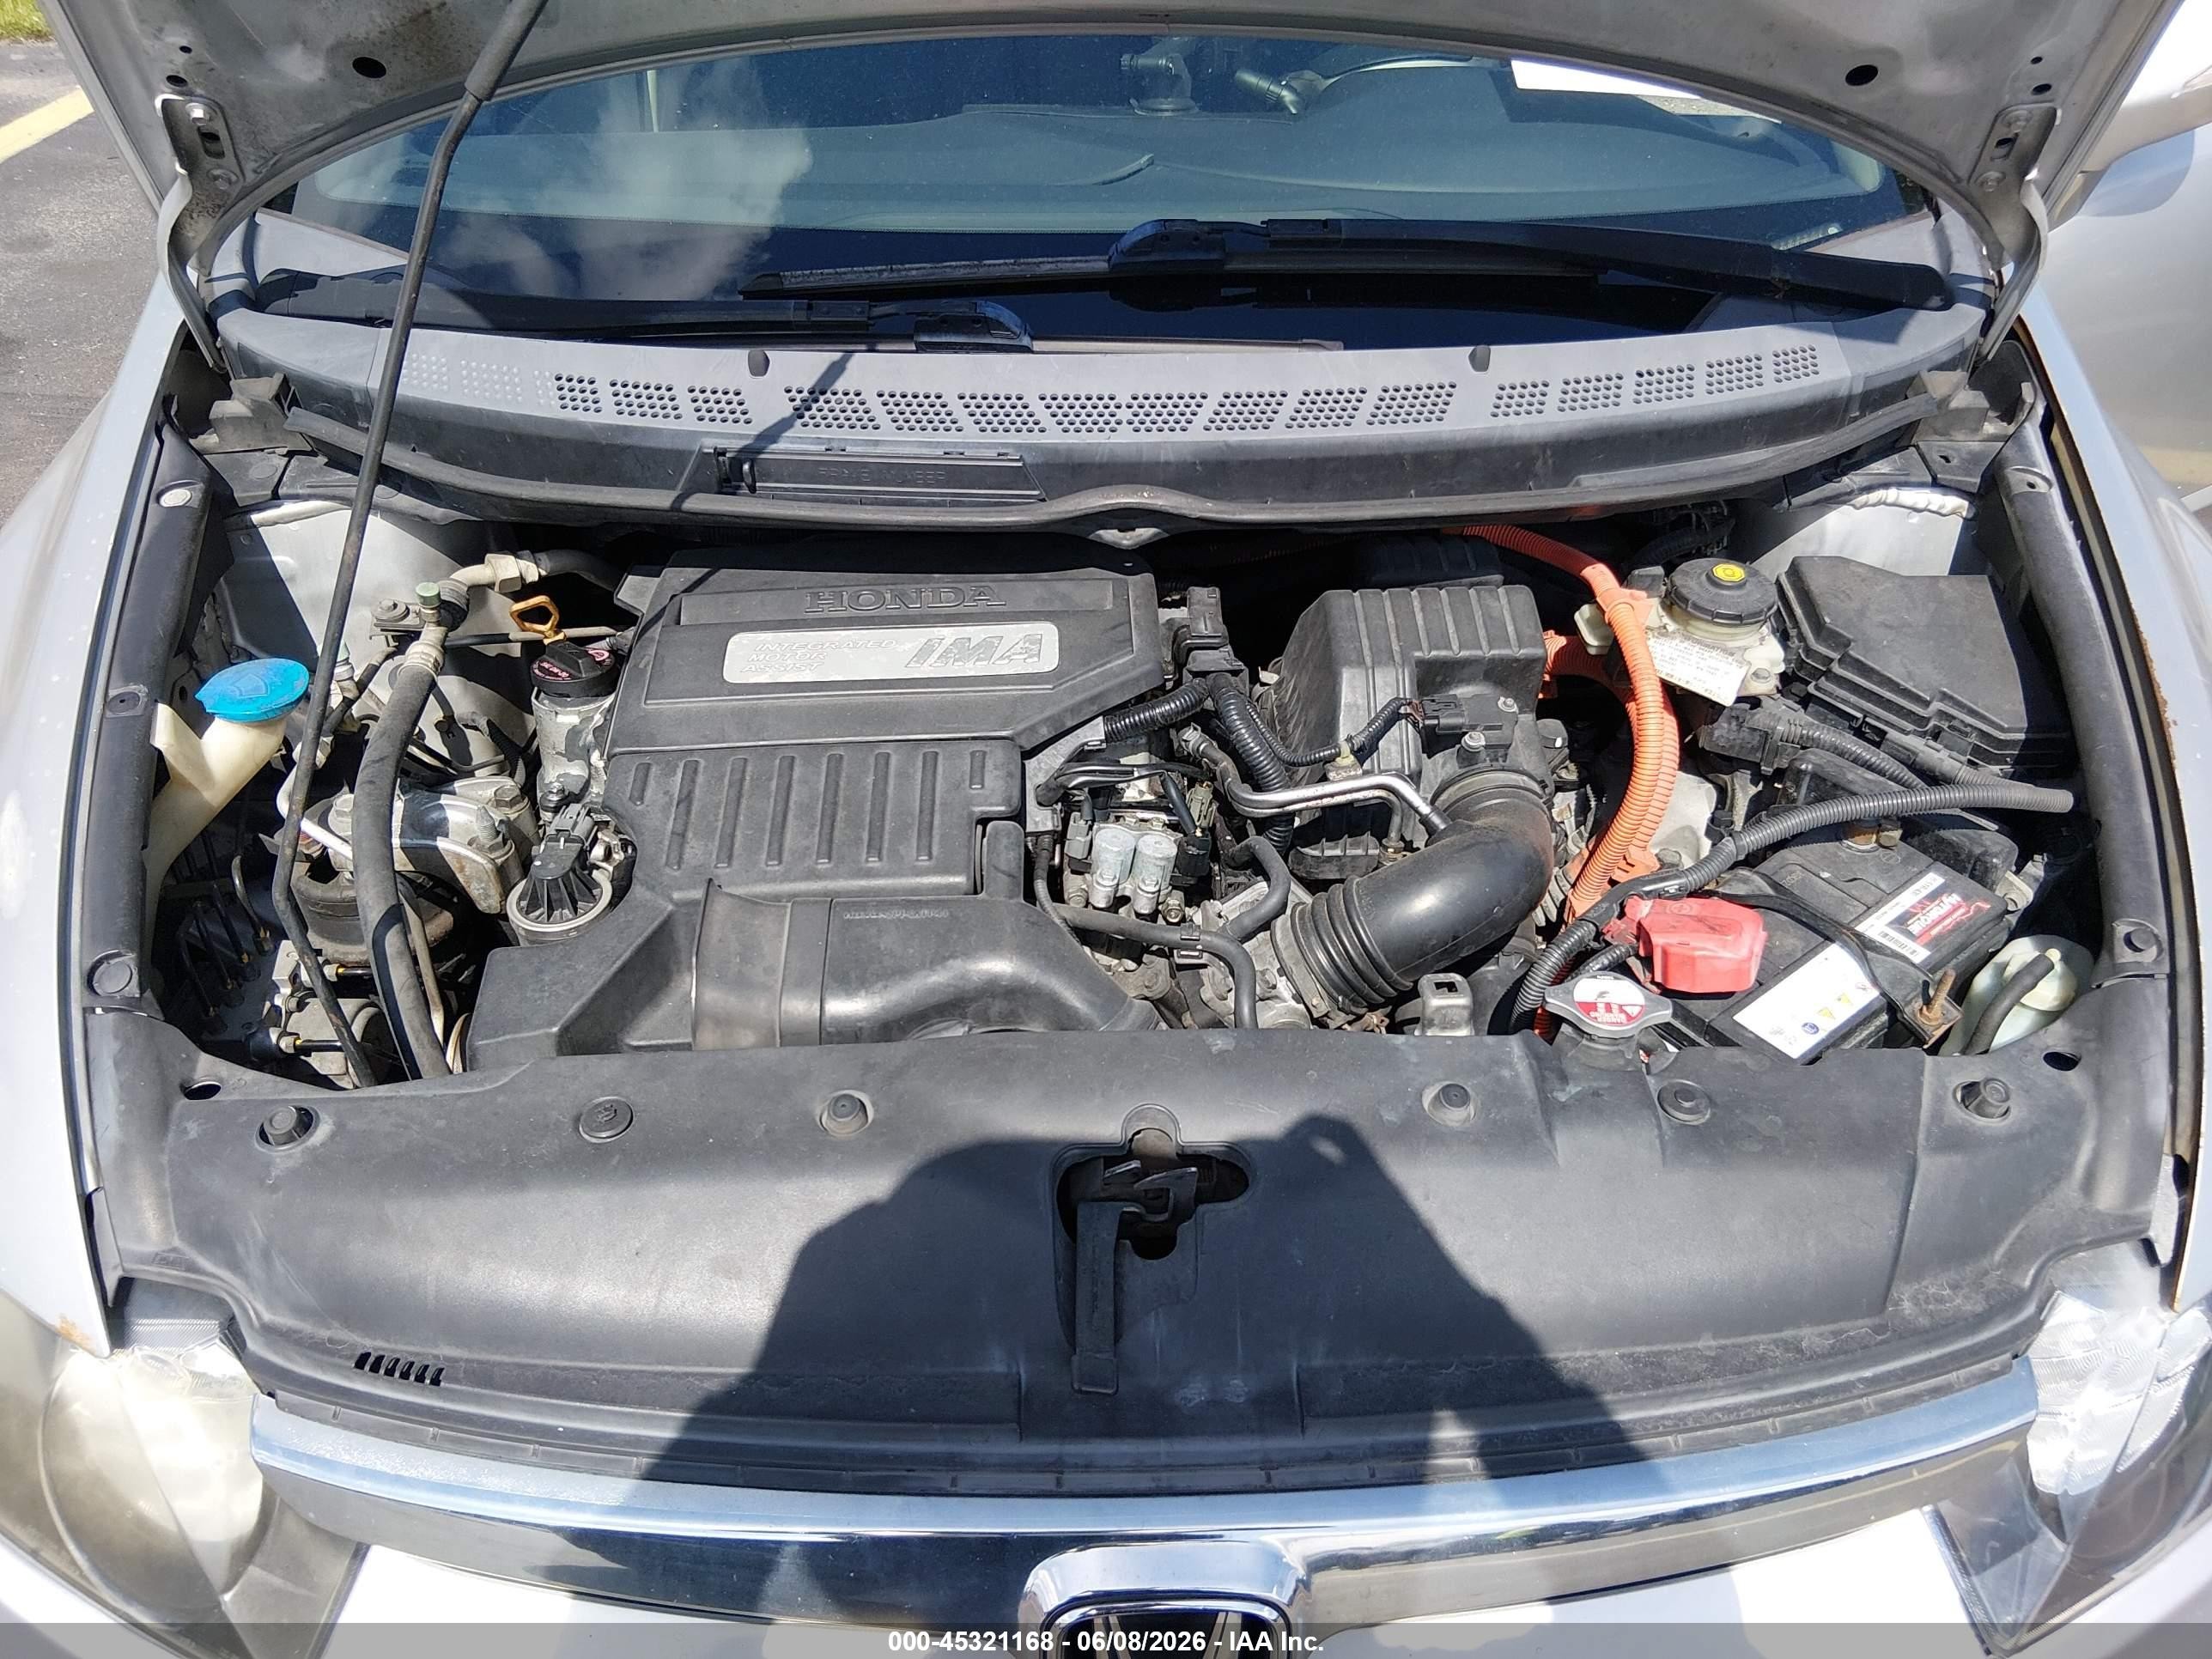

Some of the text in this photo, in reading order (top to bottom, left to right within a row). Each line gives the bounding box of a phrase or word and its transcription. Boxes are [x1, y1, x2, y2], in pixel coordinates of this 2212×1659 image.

[804, 585, 1006, 614] HONDA
[755, 639, 898, 652] INTEGRATED
[904, 633, 1043, 669] IMA
[748, 651, 828, 662] MOTOR
[740, 661, 824, 673] ASSIST
